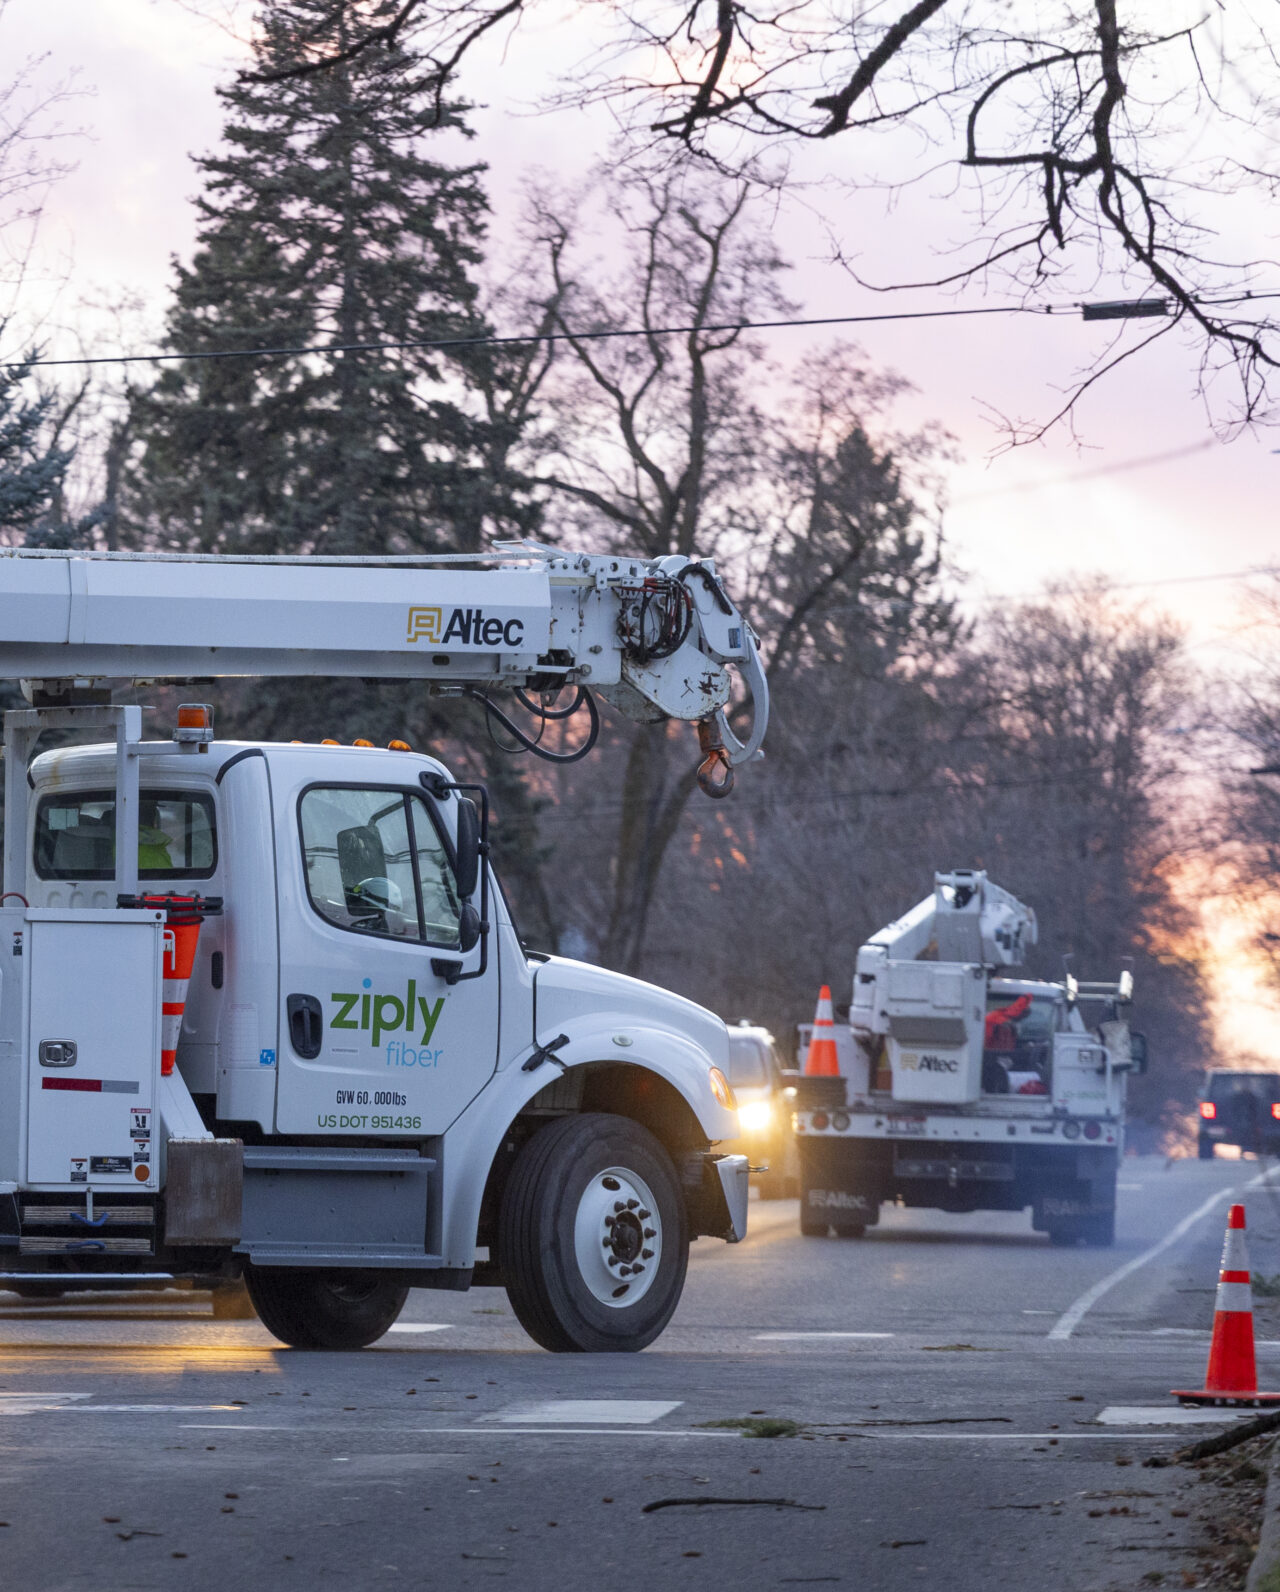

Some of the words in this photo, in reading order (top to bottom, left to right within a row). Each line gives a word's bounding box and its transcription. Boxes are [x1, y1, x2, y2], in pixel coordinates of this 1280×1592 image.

[441, 608, 524, 646] Altec
[330, 978, 446, 1047] ziply
[386, 1041, 444, 1067] fiber
[918, 1055, 959, 1073] Altec
[336, 1090, 355, 1105] GVW
[318, 1115, 337, 1128] US
[340, 1115, 369, 1128] DOT
[371, 1116, 422, 1129] 951436
